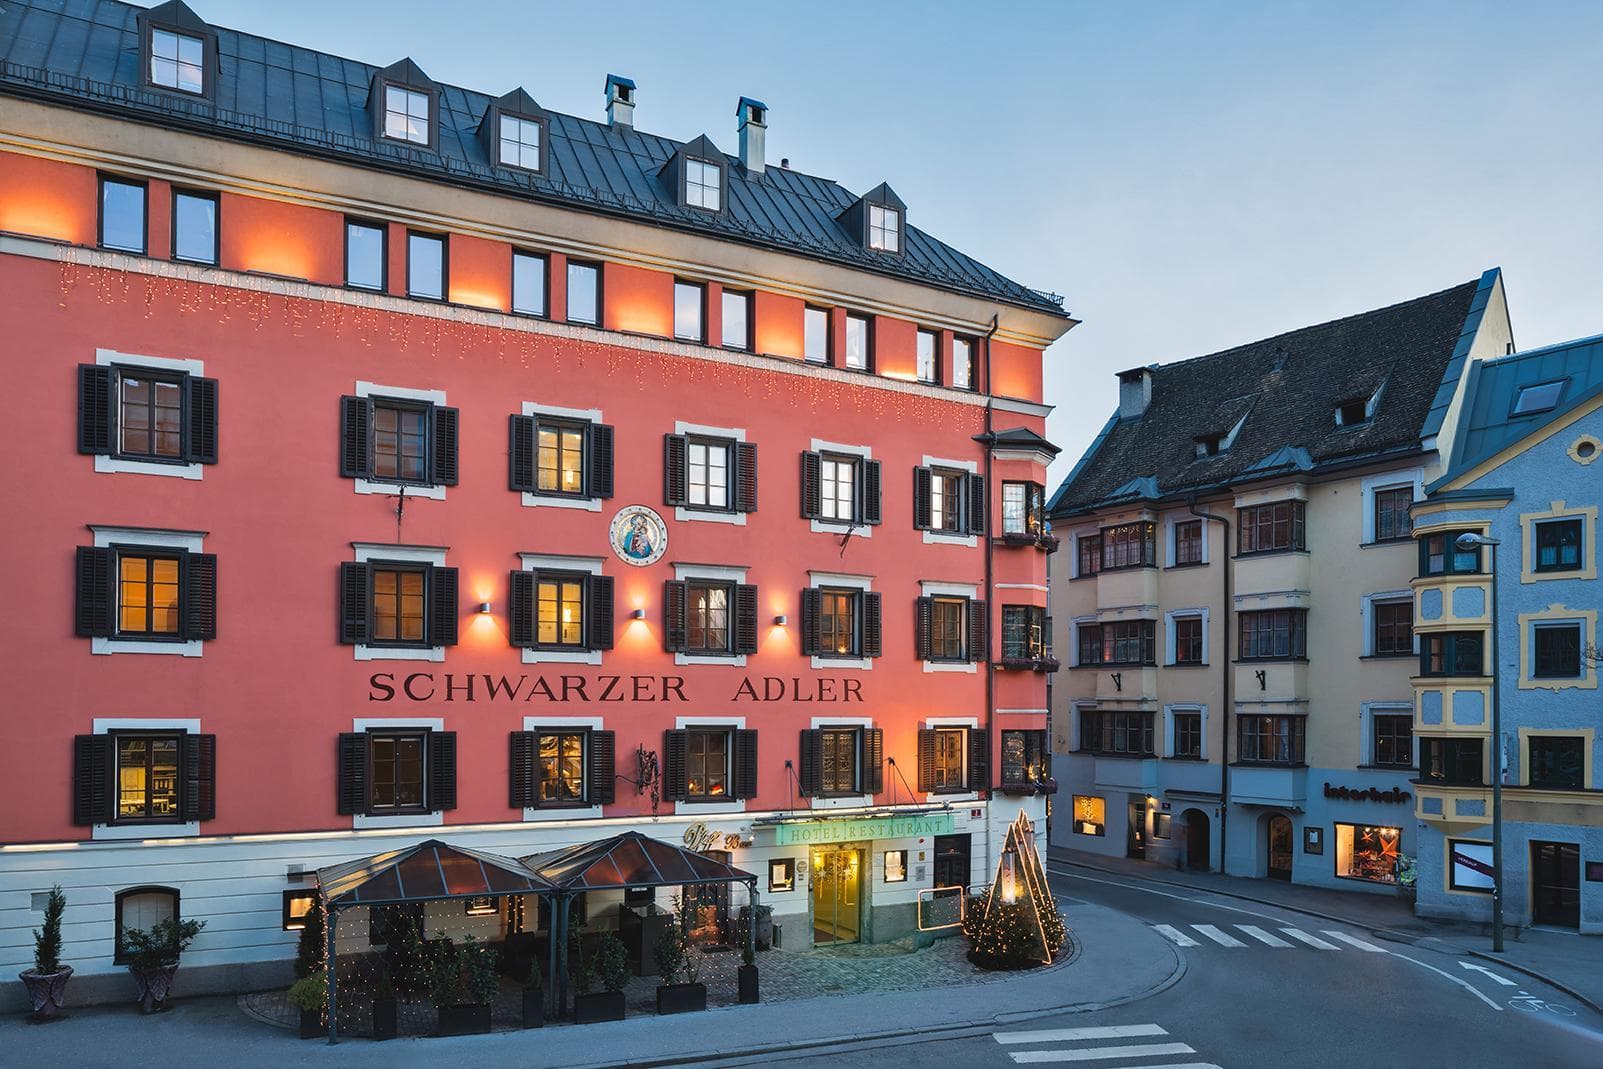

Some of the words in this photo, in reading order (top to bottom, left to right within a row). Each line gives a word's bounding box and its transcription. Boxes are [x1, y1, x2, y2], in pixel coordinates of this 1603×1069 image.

[369, 672, 690, 702] SCHWARZER
[731, 676, 864, 702] ADLER
[791, 827, 840, 841] HOTEL
[849, 821, 943, 837] RESTAURANT
